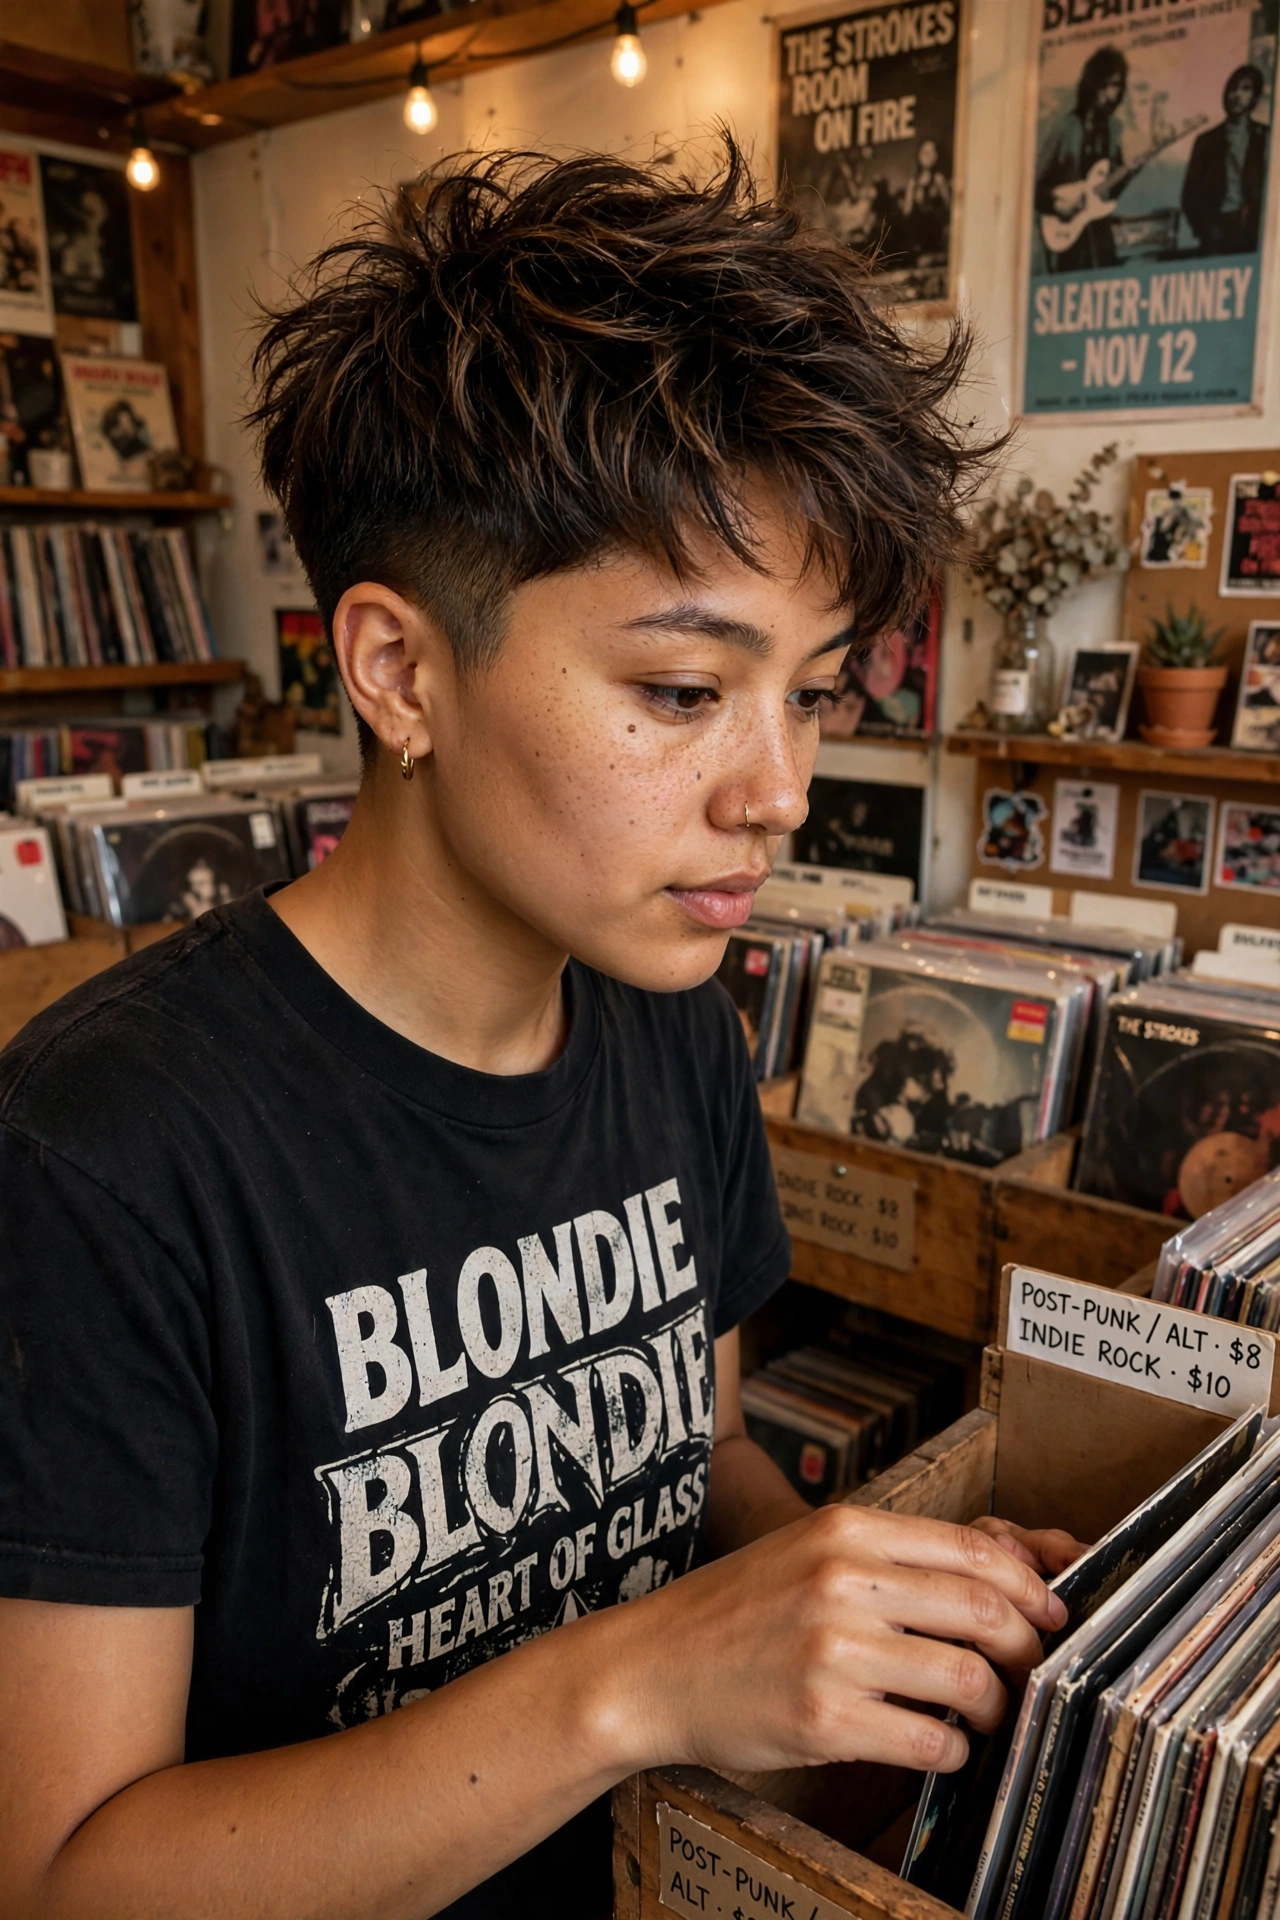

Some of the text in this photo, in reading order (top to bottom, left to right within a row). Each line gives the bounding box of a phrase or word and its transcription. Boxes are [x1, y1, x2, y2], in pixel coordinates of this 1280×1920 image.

[784, 1, 955, 75] THE STROKES
[792, 62, 868, 116] ROOM
[814, 95, 916, 153] ON FIRE
[1034, 266, 1253, 335] SLEATER-KINNEY
[1083, 333, 1149, 388] NOV
[1157, 329, 1198, 384] 12
[1117, 1015, 1201, 1047] THE STROKES
[820, 1210, 858, 1238] ROCK
[825, 1183, 864, 1209] ROCK
[325, 1177, 699, 1434] BLONDIE
[1021, 1281, 1141, 1335] POST-PUNK
[1165, 1322, 1209, 1353] ALT
[1229, 1337, 1262, 1370] $8
[1019, 1317, 1086, 1357] INDIE
[1098, 1340, 1161, 1380] ROCK
[1187, 1364, 1231, 1399] $10
[328, 1320, 716, 1631] BLONDIE
[386, 1461, 707, 1671] HEART OF GLASS
[669, 1826, 797, 1920] POST-PUNK
[670, 1871, 711, 1912] ALT
